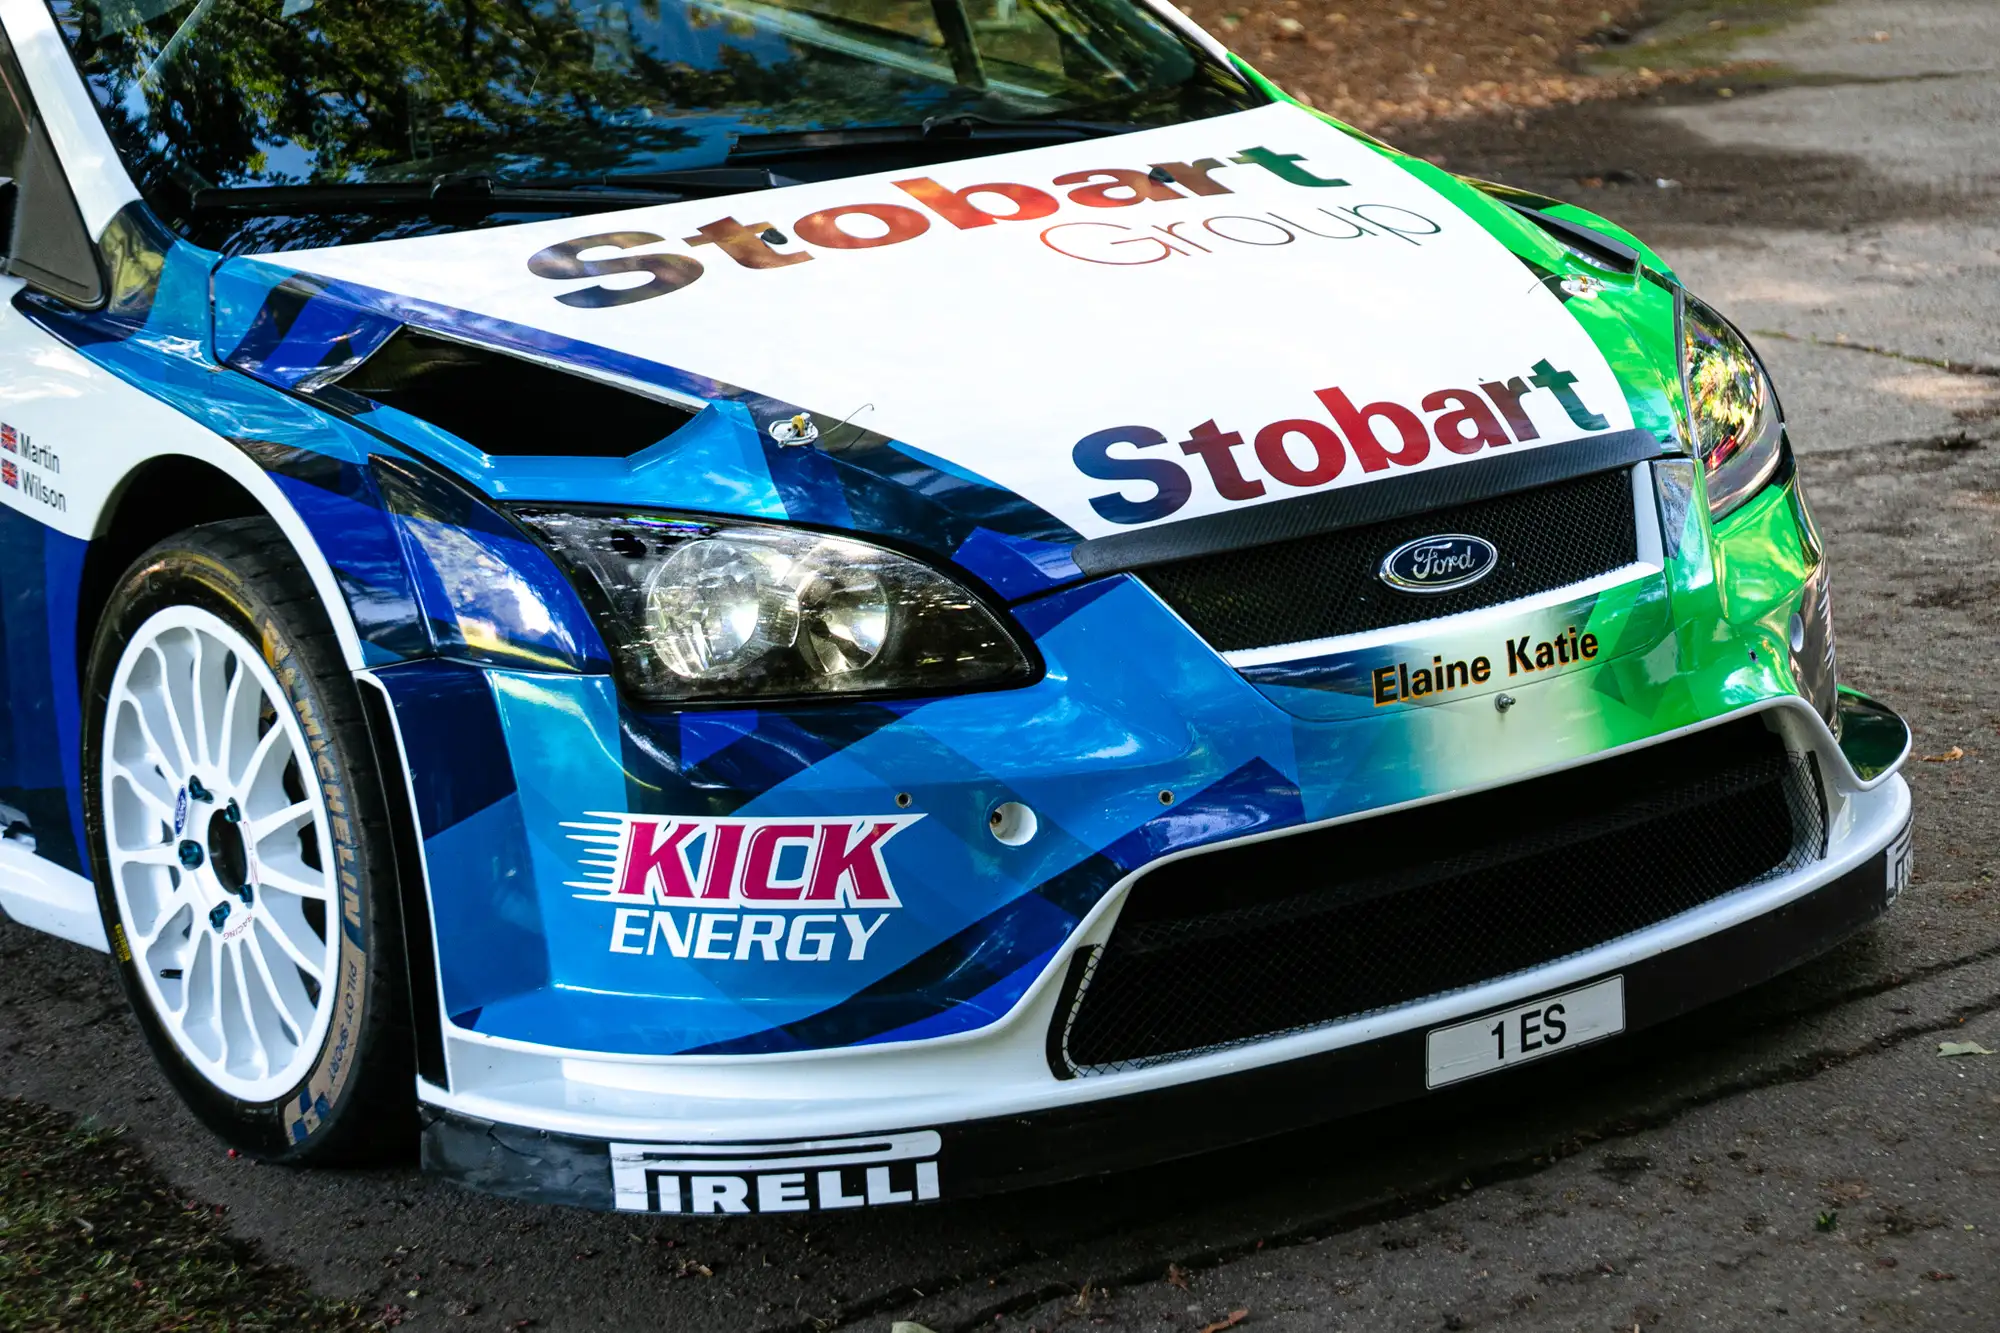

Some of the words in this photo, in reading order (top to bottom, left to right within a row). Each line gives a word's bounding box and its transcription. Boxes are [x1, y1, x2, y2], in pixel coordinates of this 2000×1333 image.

[527, 145, 1351, 309] Stobart
[1039, 204, 1441, 265] Group
[20, 431, 60, 474] Martin
[1072, 358, 1611, 524] Stobart
[21, 469, 66, 512] Wilson
[1412, 542, 1475, 579] Ford
[1372, 655, 1491, 707] Elaine
[1506, 626, 1599, 677] Katie
[296, 697, 361, 928] MICHELIN
[617, 821, 898, 901] KICK
[609, 907, 890, 962] ENERGY
[345, 961, 357, 1024] PILOT
[329, 1023, 349, 1082] SPORT
[1490, 1020, 1504, 1060] 1
[1520, 1003, 1567, 1053] ES
[609, 1130, 942, 1213] PIRELLI
